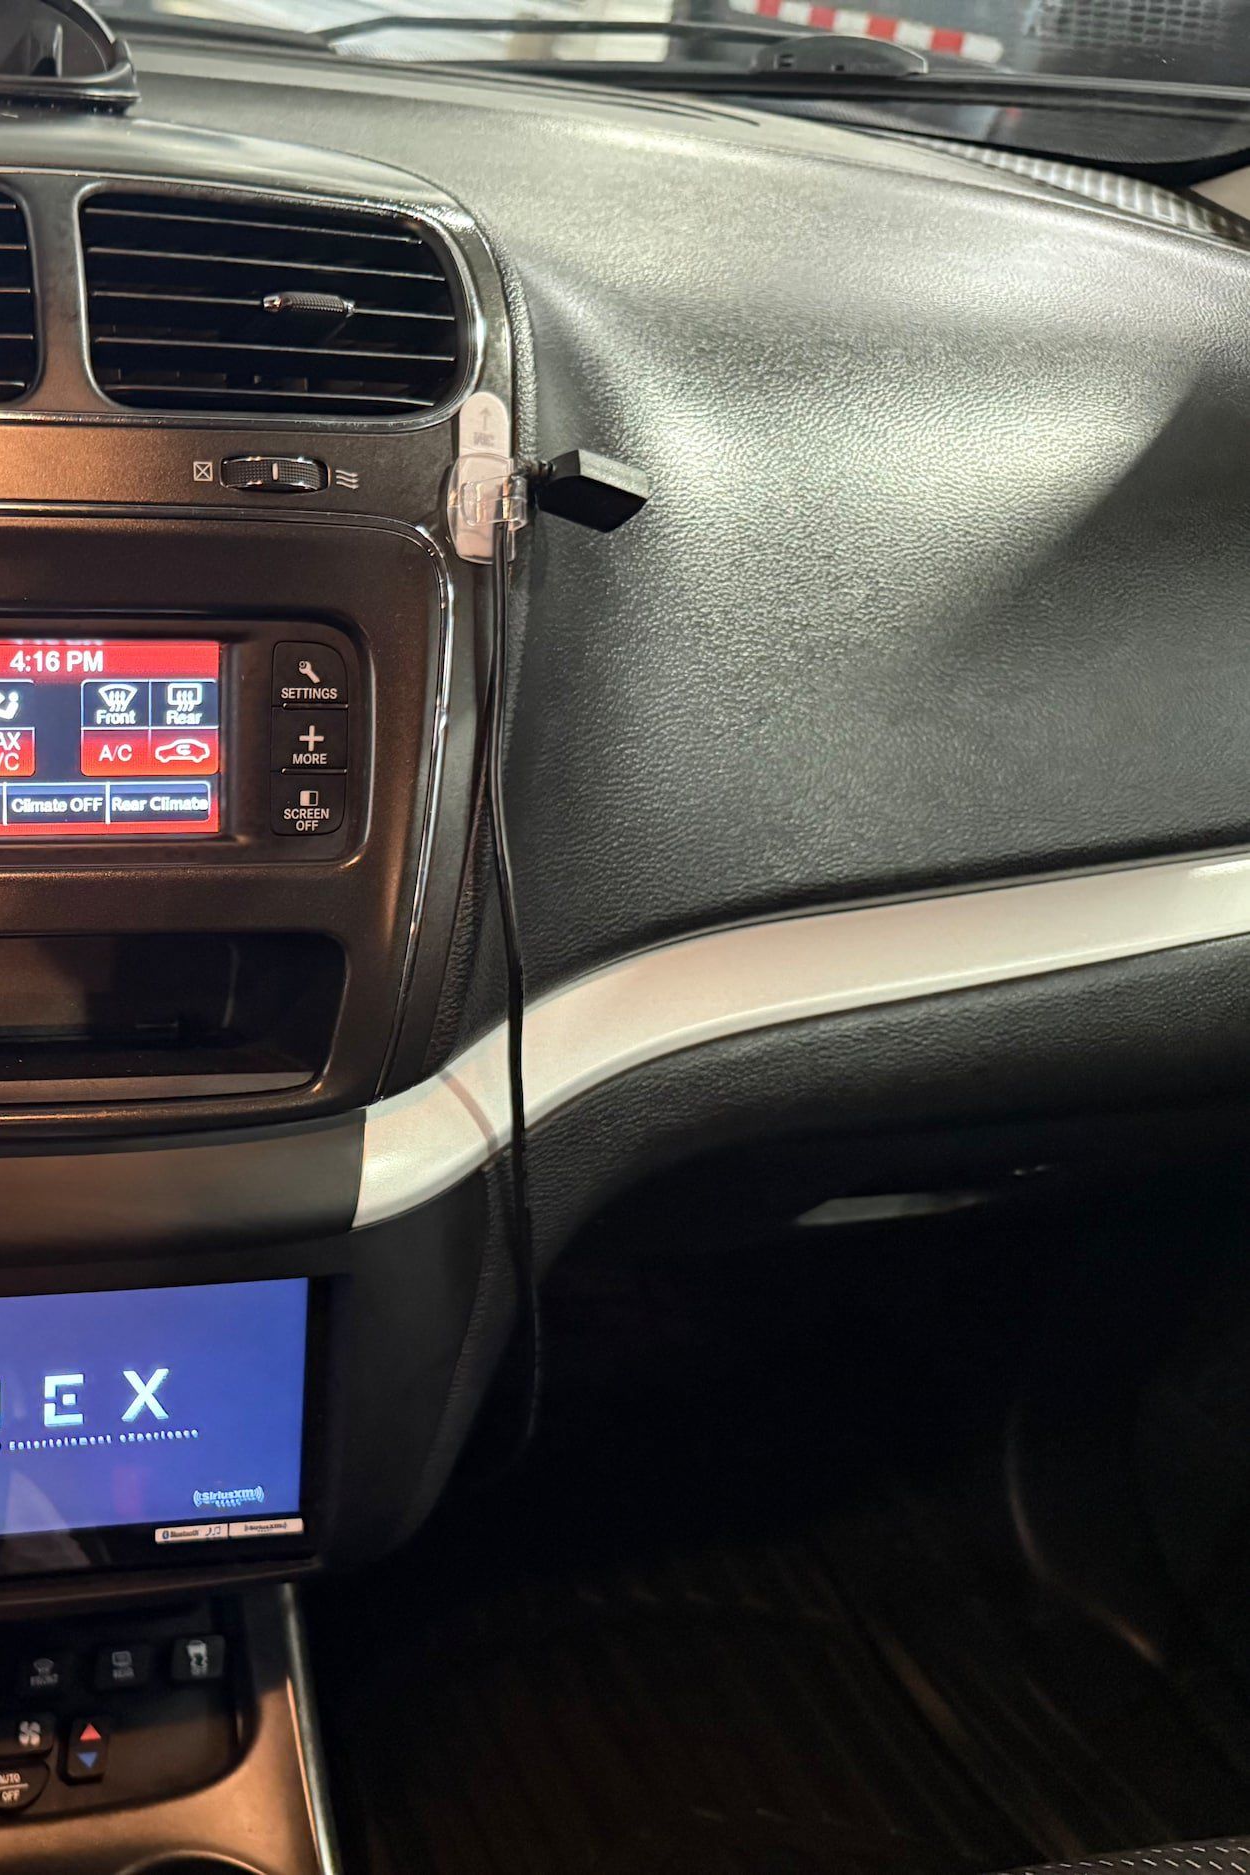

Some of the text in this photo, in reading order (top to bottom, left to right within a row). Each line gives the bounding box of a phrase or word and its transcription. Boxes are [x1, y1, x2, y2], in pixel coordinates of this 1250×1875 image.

[9, 650, 104, 673] 4:16 PM
[280, 687, 338, 700] SETTINGS
[96, 710, 136, 725] Front
[166, 710, 203, 725] Rear
[98, 744, 133, 762] A/C
[292, 753, 327, 765] MORE
[11, 797, 103, 813] Climate OFF
[111, 796, 209, 812] Rear Climate
[283, 808, 330, 820] SCREEN
[295, 820, 319, 832] OFF
[1, 1790, 20, 1802] OFF
